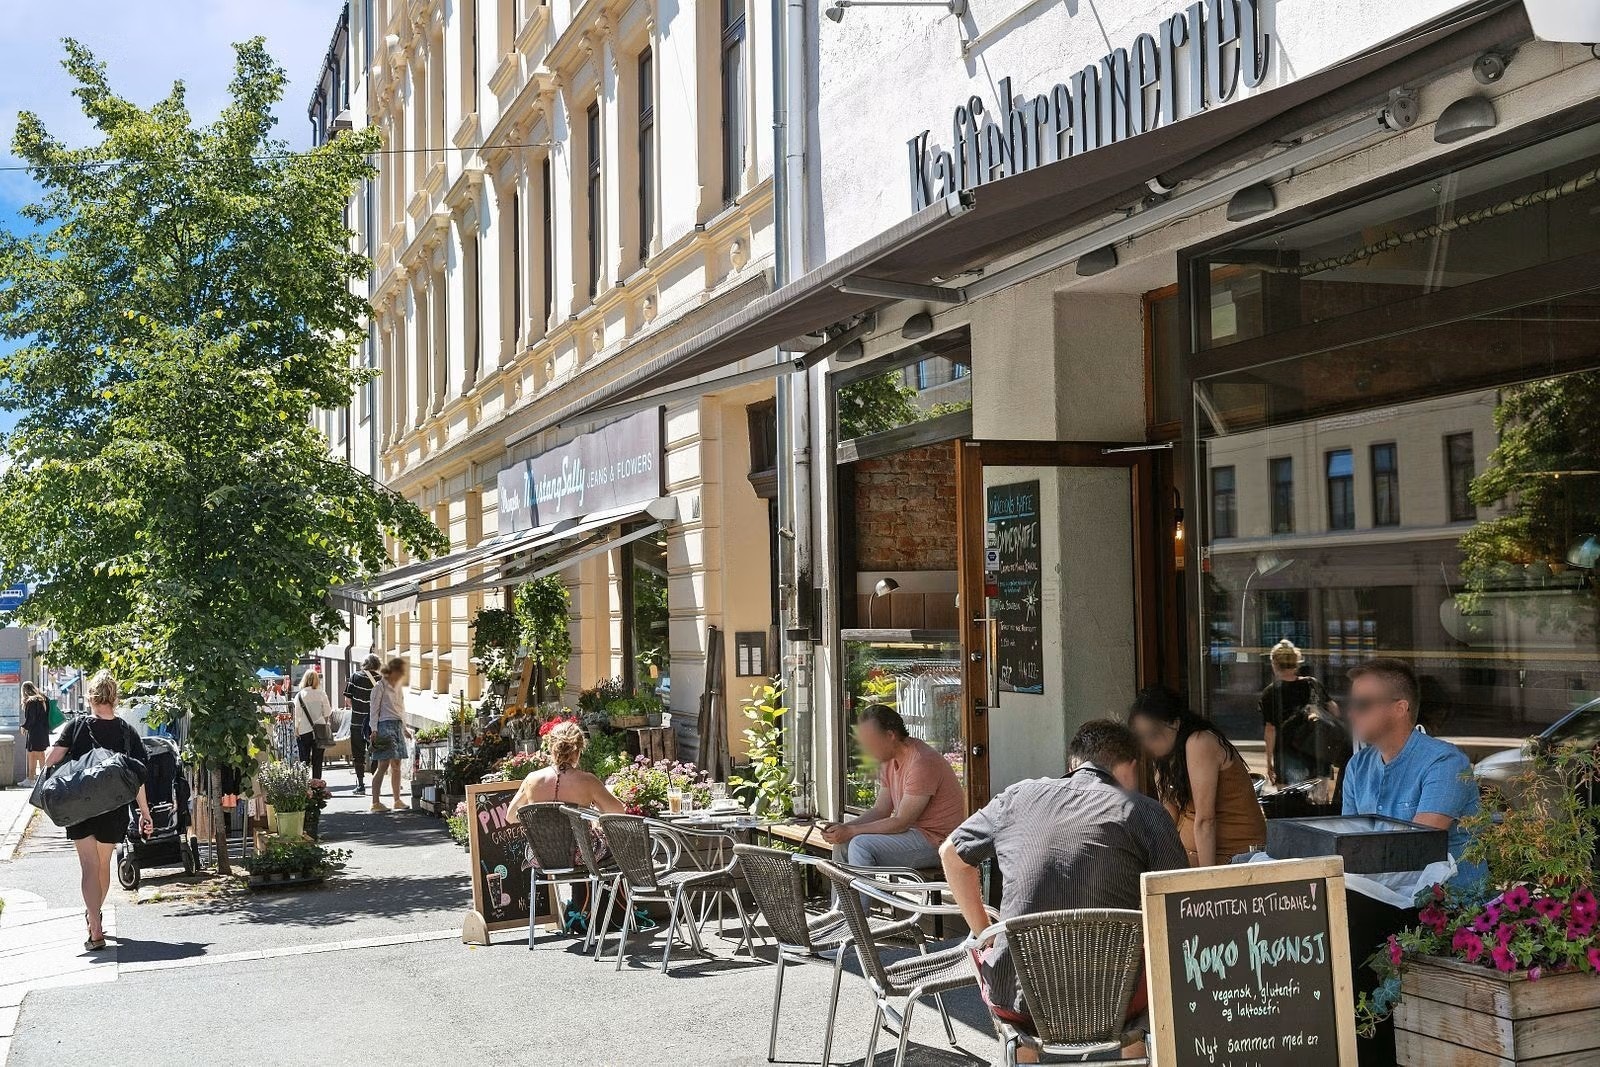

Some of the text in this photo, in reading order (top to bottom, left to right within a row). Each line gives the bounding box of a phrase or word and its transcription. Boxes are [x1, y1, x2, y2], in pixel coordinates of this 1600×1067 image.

[907, 0, 1270, 214] Kaffebrenneriet
[587, 467, 607, 488] JEANS
[610, 465, 615, 482] &
[617, 451, 652, 480] FLOWERS
[895, 676, 926, 718] Kaffe
[478, 802, 508, 834] PIN
[491, 825, 528, 845] GRAPEFR
[1180, 883, 1317, 919] FAVORITTEN ER TILBAKE!
[1182, 934, 1239, 991] KOKO
[1260, 979, 1300, 1003] glutenfri
[1222, 999, 1280, 1022] og laktosefri
[1195, 1030, 1319, 1063] Nyt sammen med en
